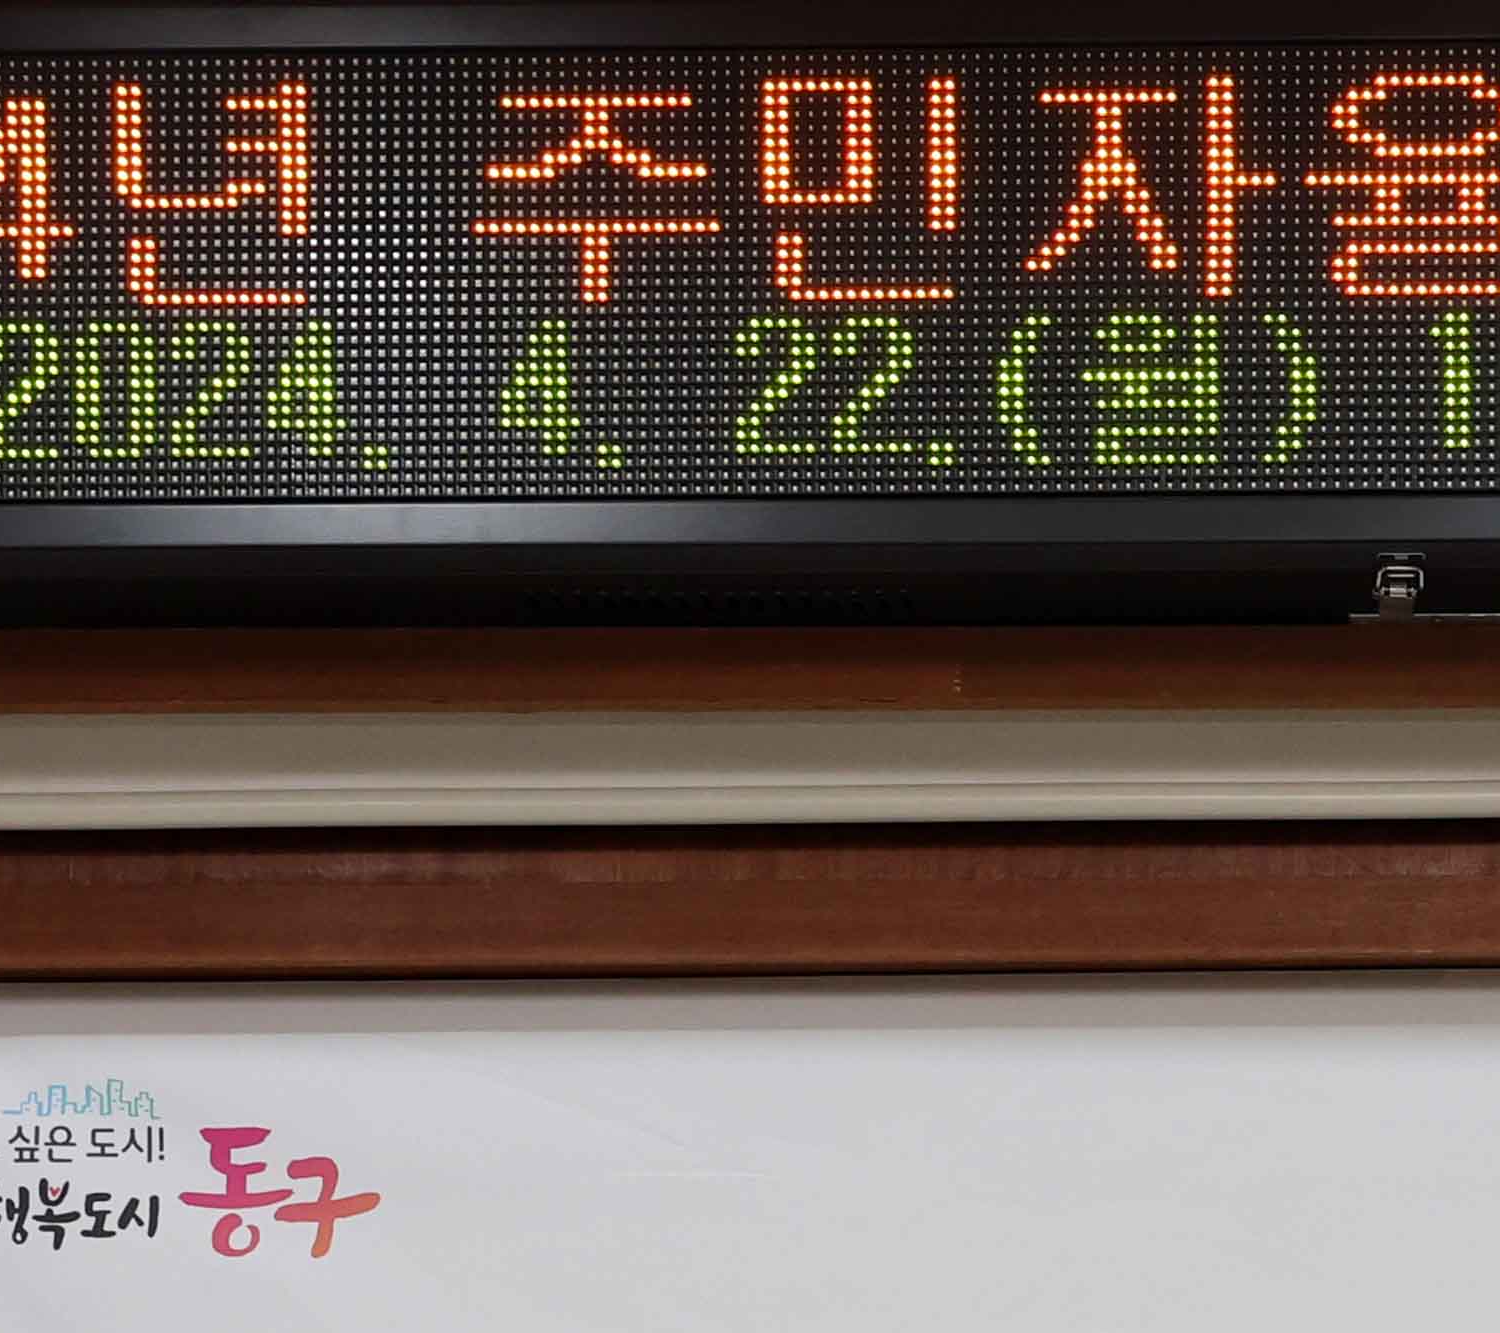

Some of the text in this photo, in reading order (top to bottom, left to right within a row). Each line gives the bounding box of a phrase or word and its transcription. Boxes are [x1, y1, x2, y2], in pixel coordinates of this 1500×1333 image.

[496, 315, 627, 470] 4.
[7, 1123, 77, 1164] 싶은
[85, 1123, 167, 1164] 도시!
[178, 1126, 381, 1259] 동구
